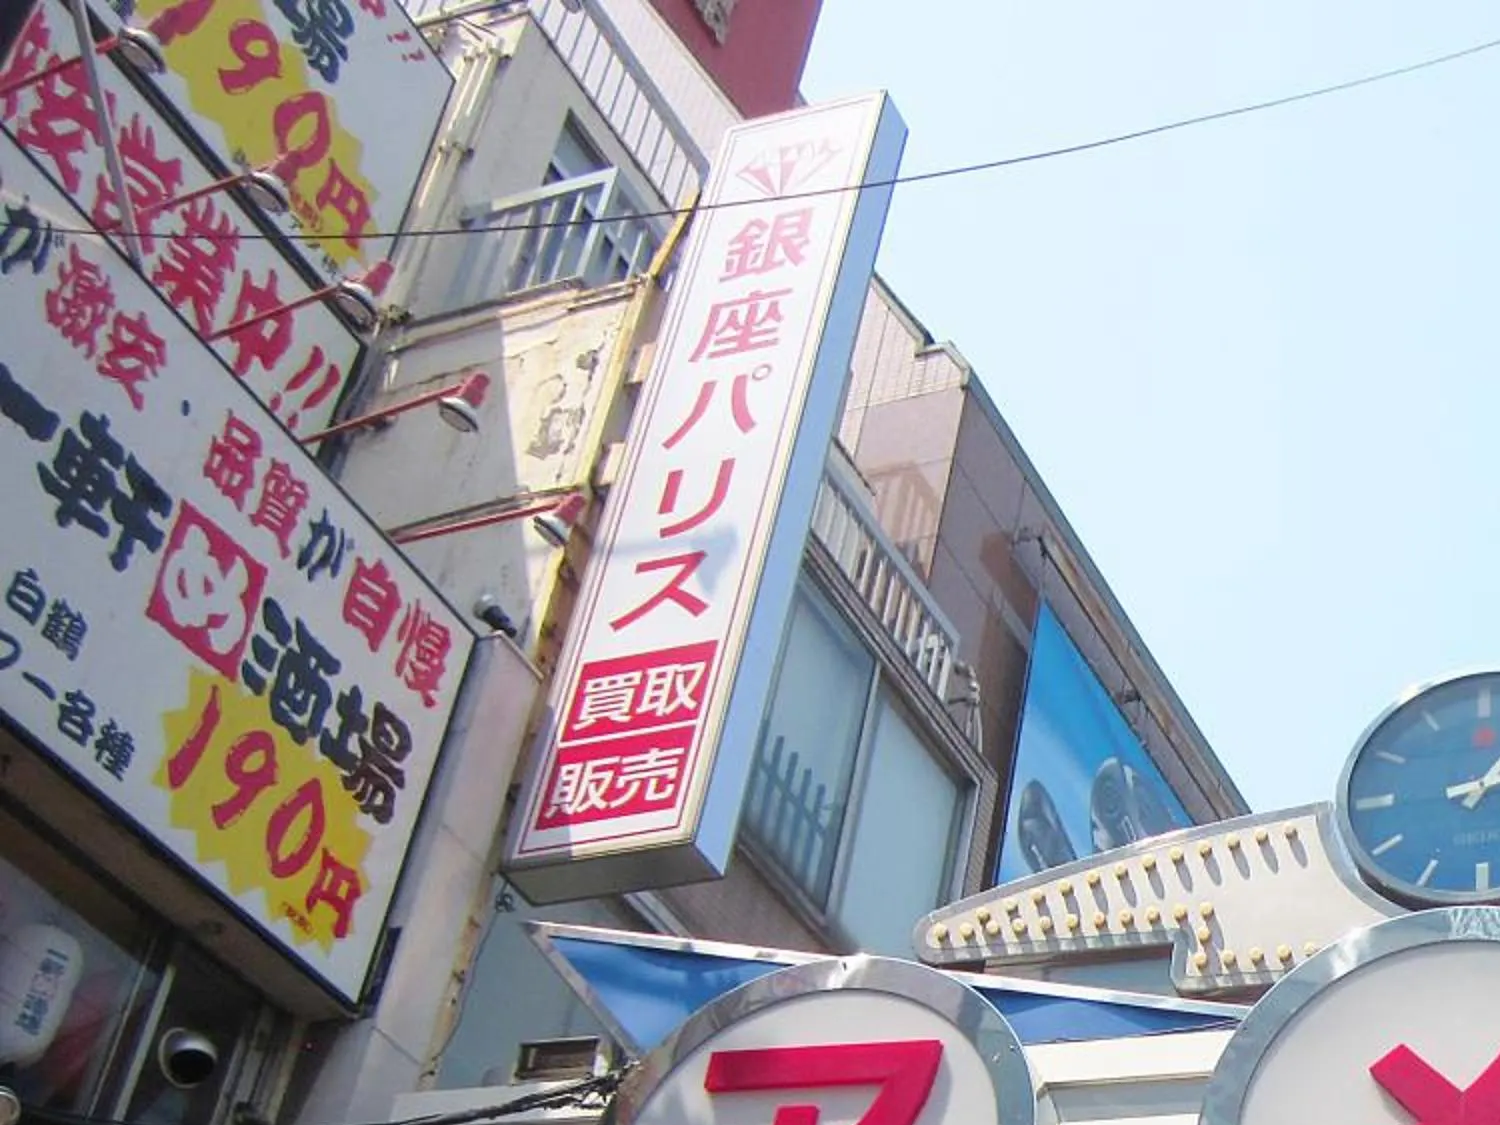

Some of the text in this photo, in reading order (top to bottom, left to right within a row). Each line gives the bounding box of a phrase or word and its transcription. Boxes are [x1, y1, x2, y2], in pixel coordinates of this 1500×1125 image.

[608, 206, 814, 632] 銀座パリス
[572, 660, 706, 731] 買取
[168, 684, 363, 938] 190円
[544, 747, 684, 818] 販売
